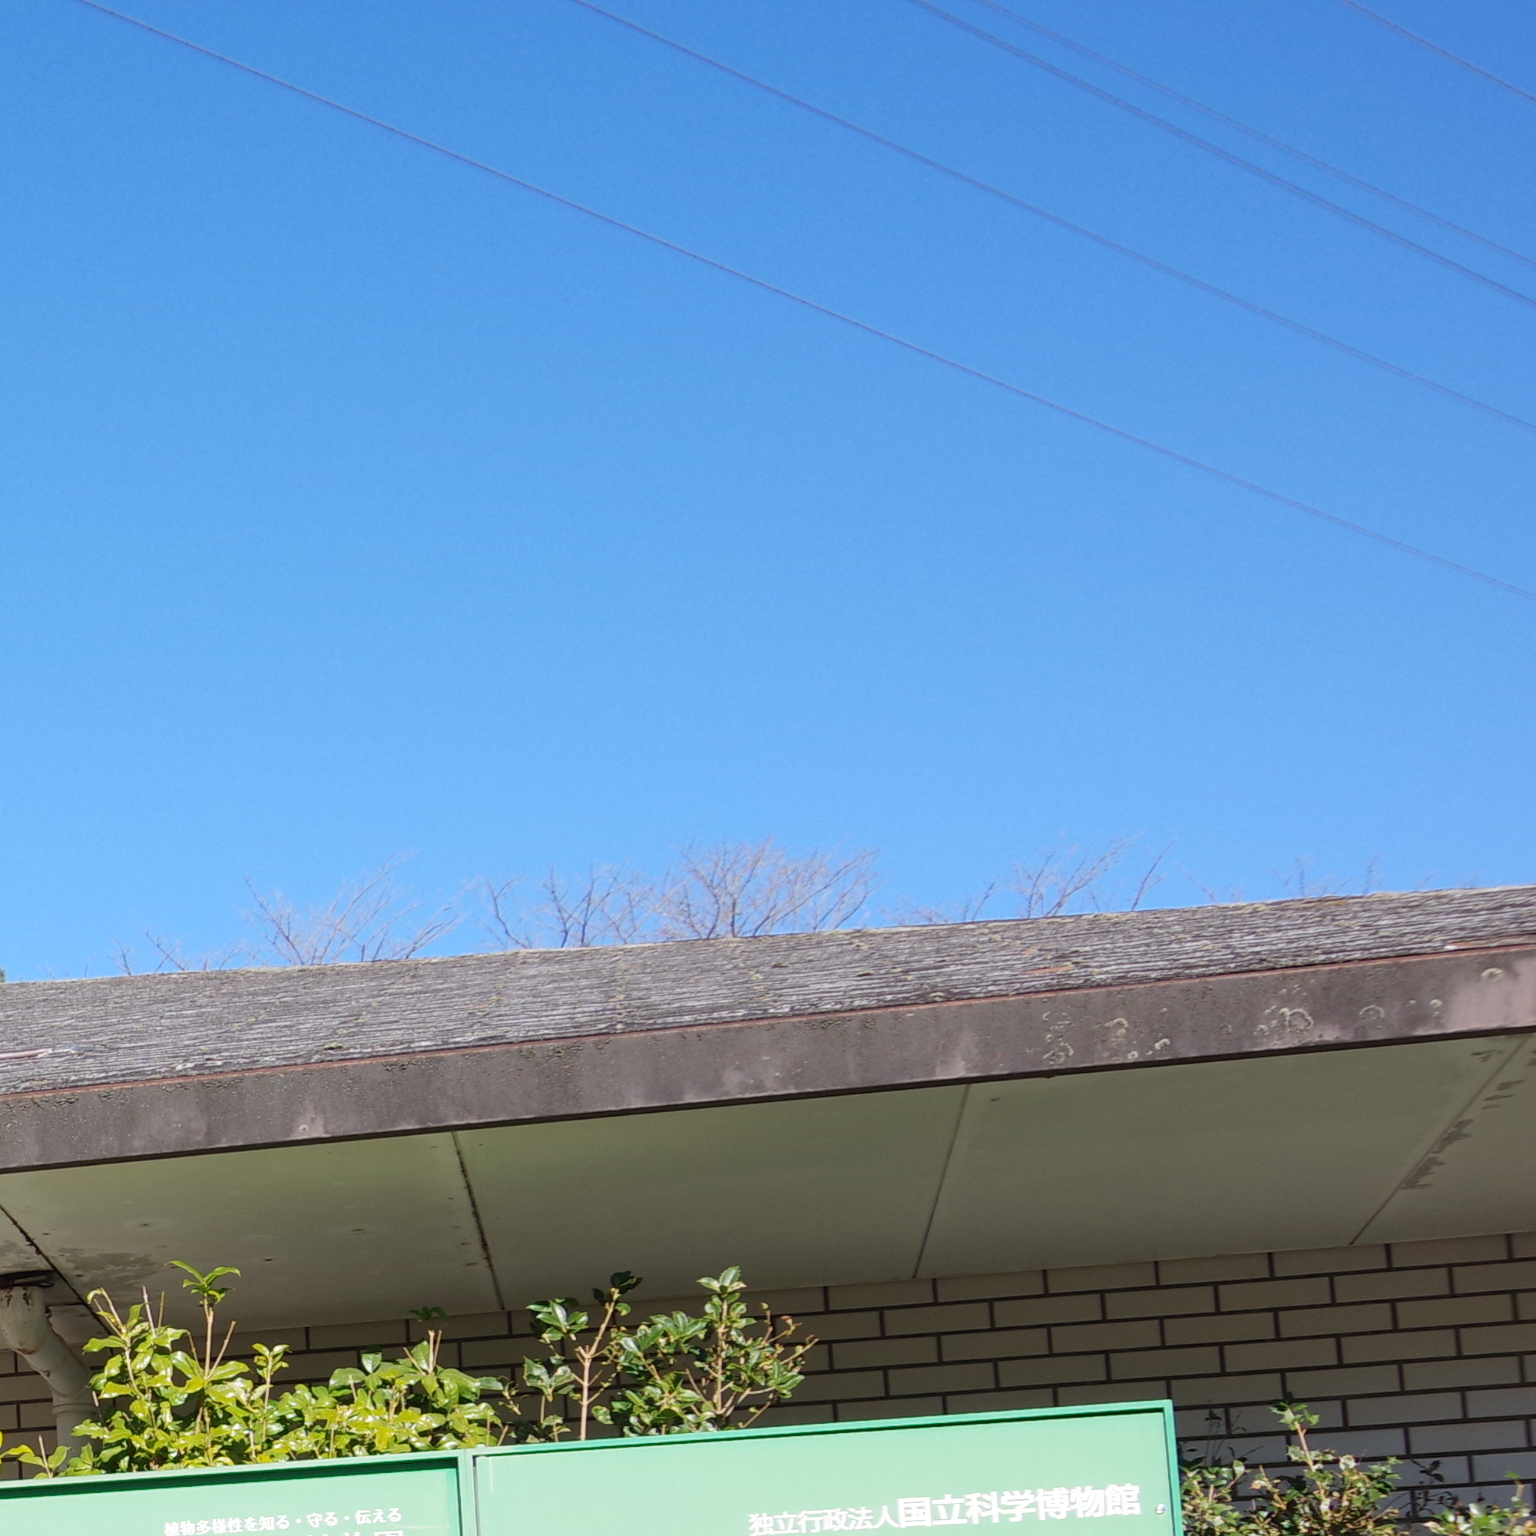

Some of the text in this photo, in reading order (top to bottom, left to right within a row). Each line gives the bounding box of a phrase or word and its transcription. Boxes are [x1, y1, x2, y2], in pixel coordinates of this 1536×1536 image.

[164, 1508, 402, 1536] 植物多様性を知る・守る・伝える
[749, 1484, 1141, 1536] 独立行政法人国立科学博物館
